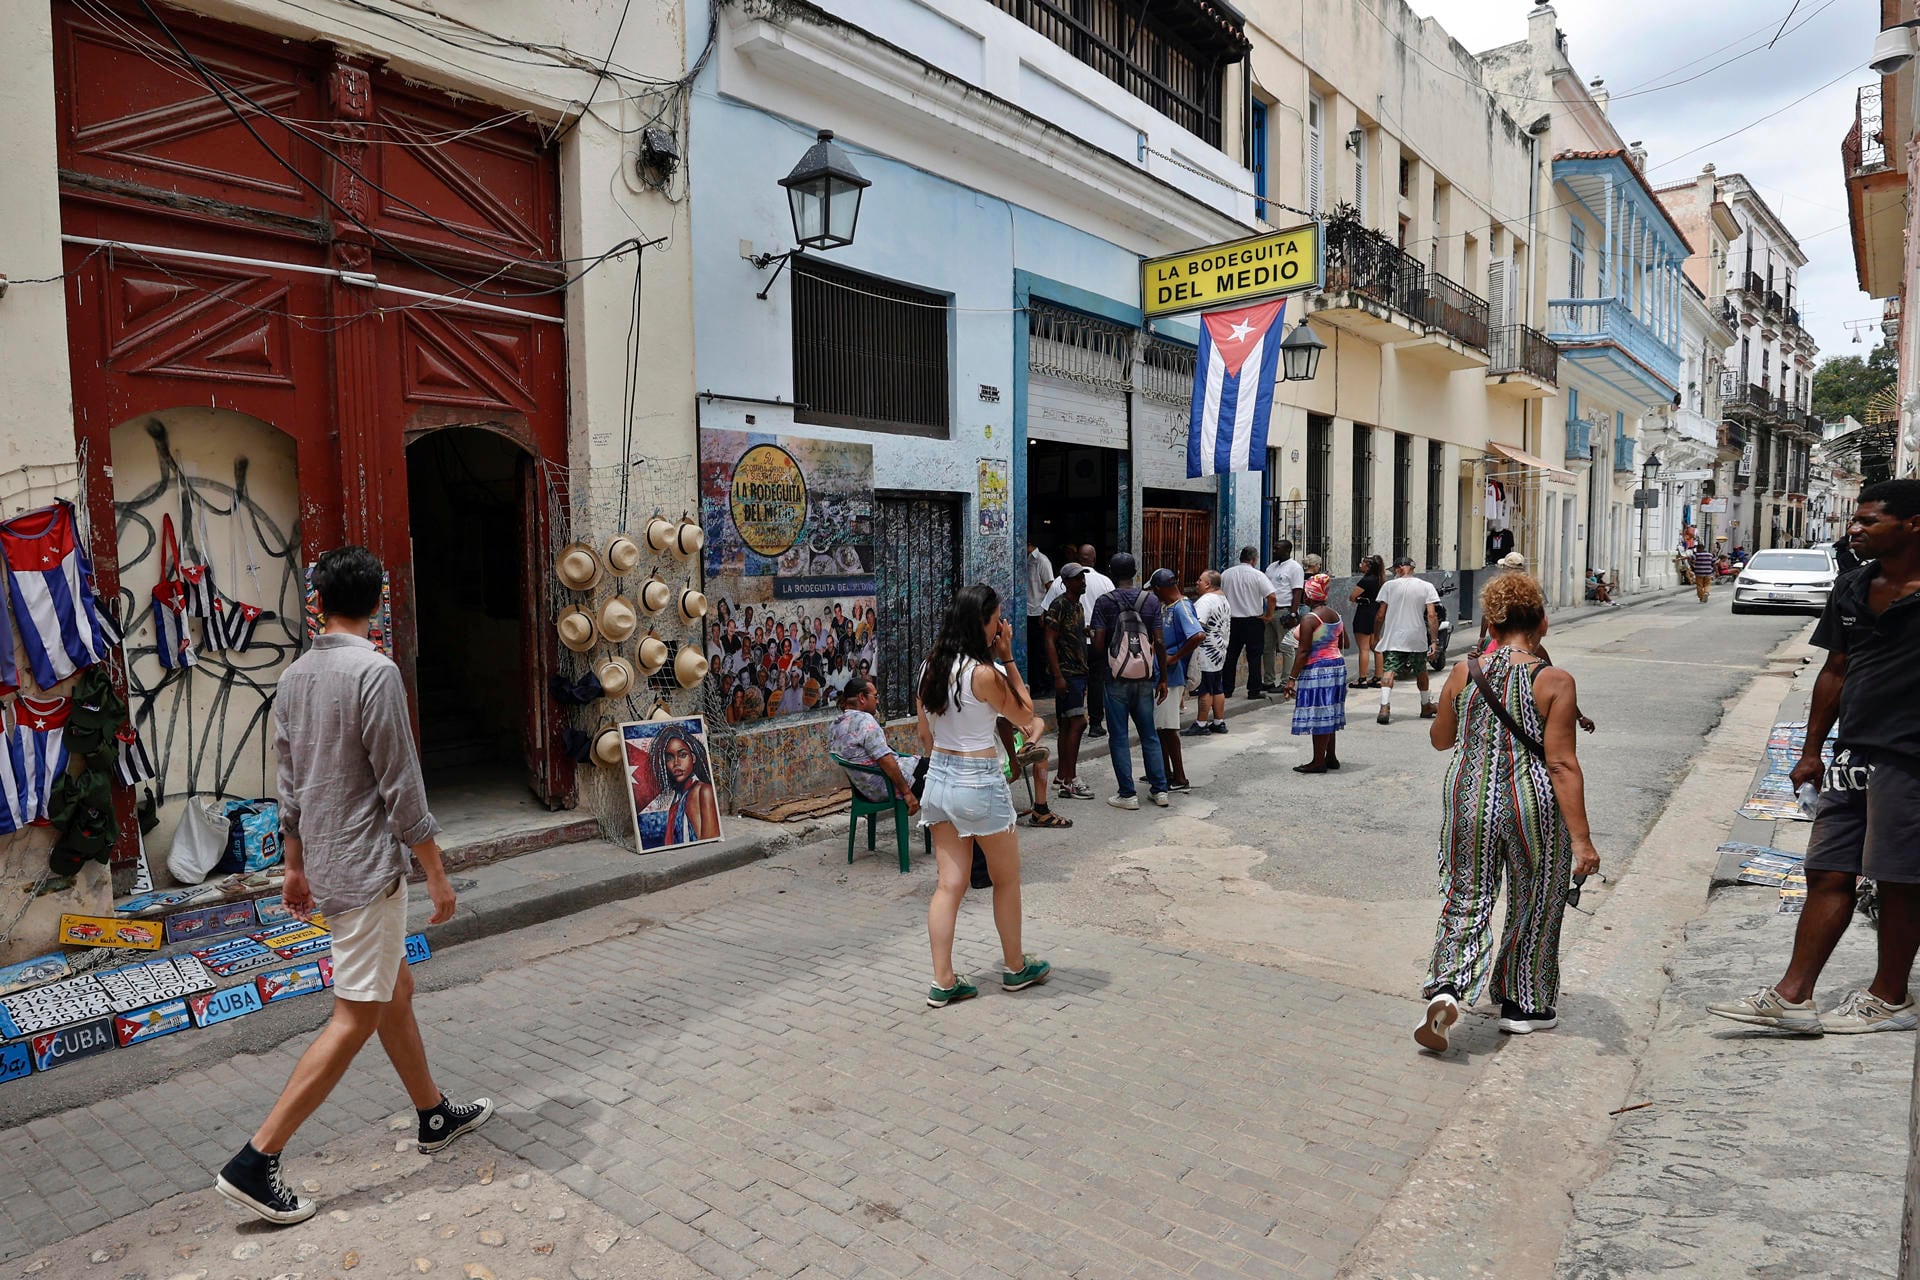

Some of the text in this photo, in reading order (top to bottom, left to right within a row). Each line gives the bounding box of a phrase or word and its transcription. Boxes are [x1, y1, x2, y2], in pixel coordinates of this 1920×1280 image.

[1158, 240, 1298, 281] LA BODEGUITA
[1158, 260, 1299, 304] DEL MEDIO
[736, 481, 802, 502] LA BODEGUITA
[744, 504, 760, 521] DEL
[783, 584, 792, 593] LA
[794, 583, 835, 593] BODEGUITA
[228, 957, 275, 972] Cuba
[126, 979, 213, 1008] P140293
[206, 990, 256, 1017] CUBA
[18, 1003, 112, 1033] K235361
[51, 1026, 107, 1057] CUBA
